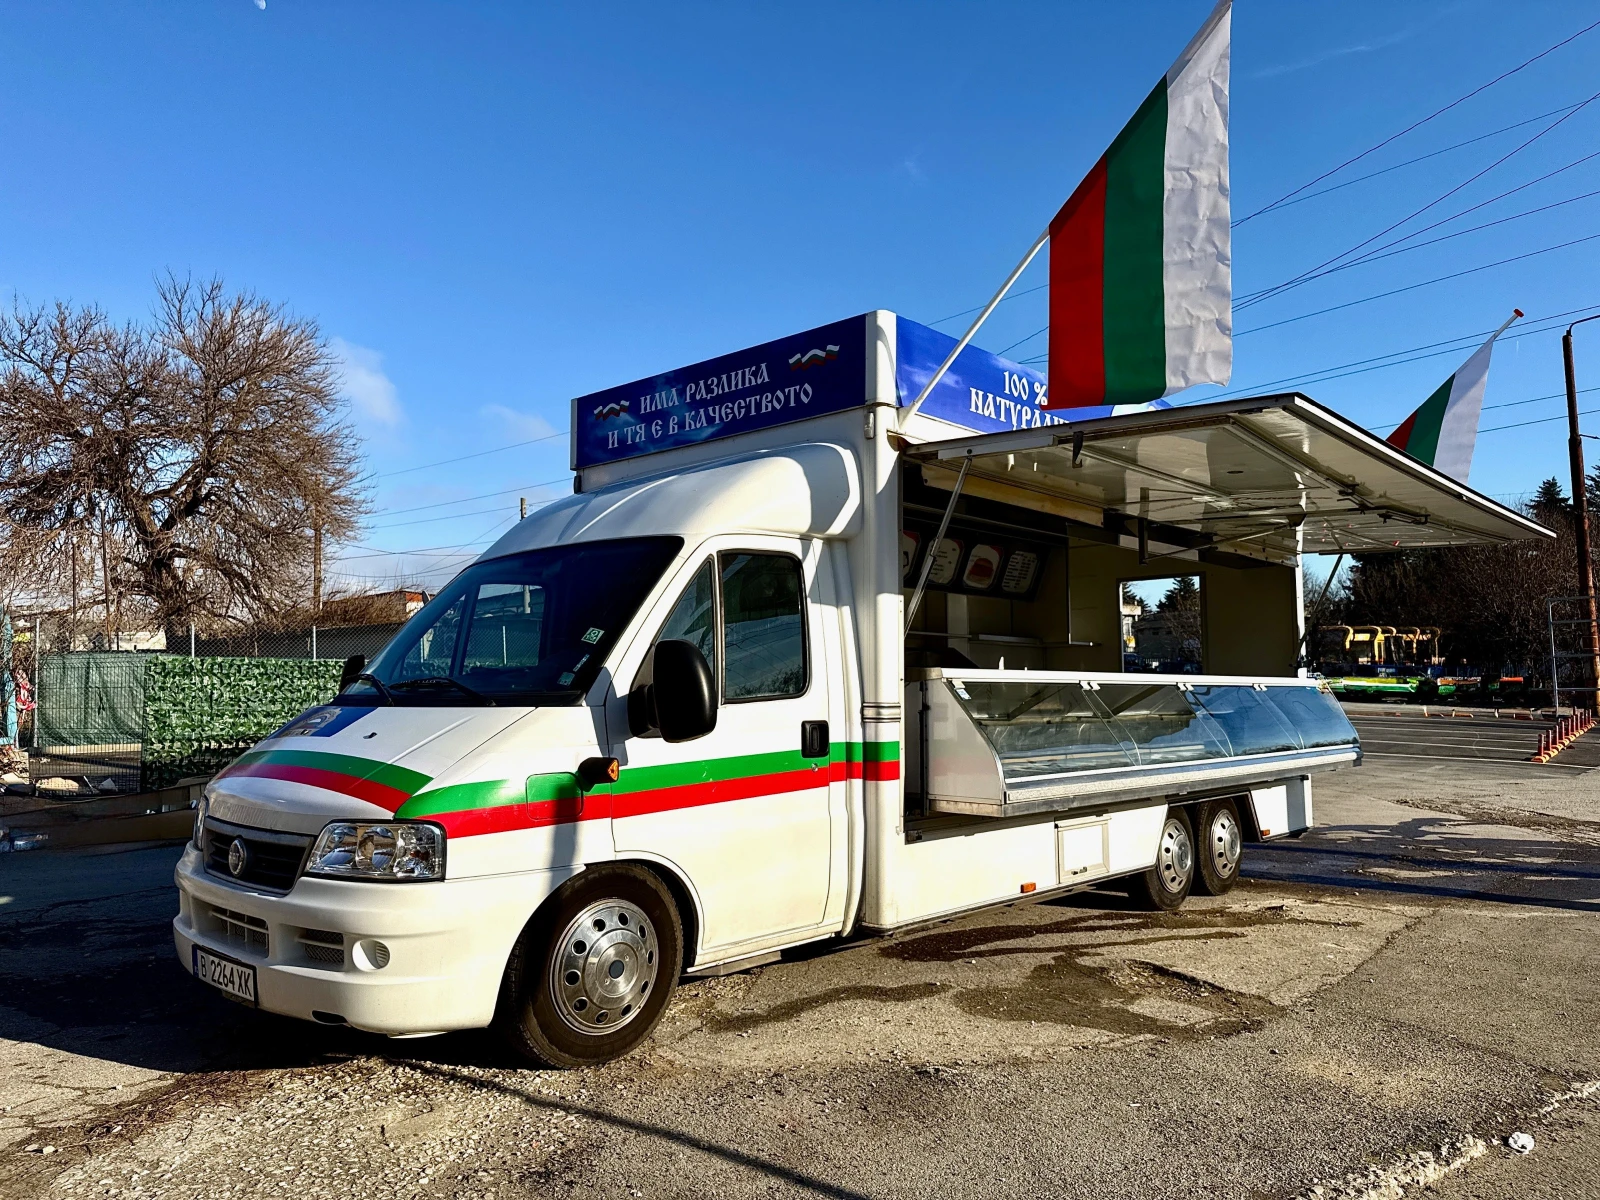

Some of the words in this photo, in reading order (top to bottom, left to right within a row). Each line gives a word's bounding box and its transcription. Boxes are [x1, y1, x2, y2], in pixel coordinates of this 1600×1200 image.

[640, 387, 679, 414] ИМА
[685, 362, 770, 403] РАЗЛИКА
[1004, 371, 1029, 401] 100
[1034, 381, 1048, 406] %
[608, 430, 619, 449] И
[624, 423, 646, 445] ТЯ
[668, 415, 678, 435] В
[684, 383, 813, 431] КАЧЕСТВОТО
